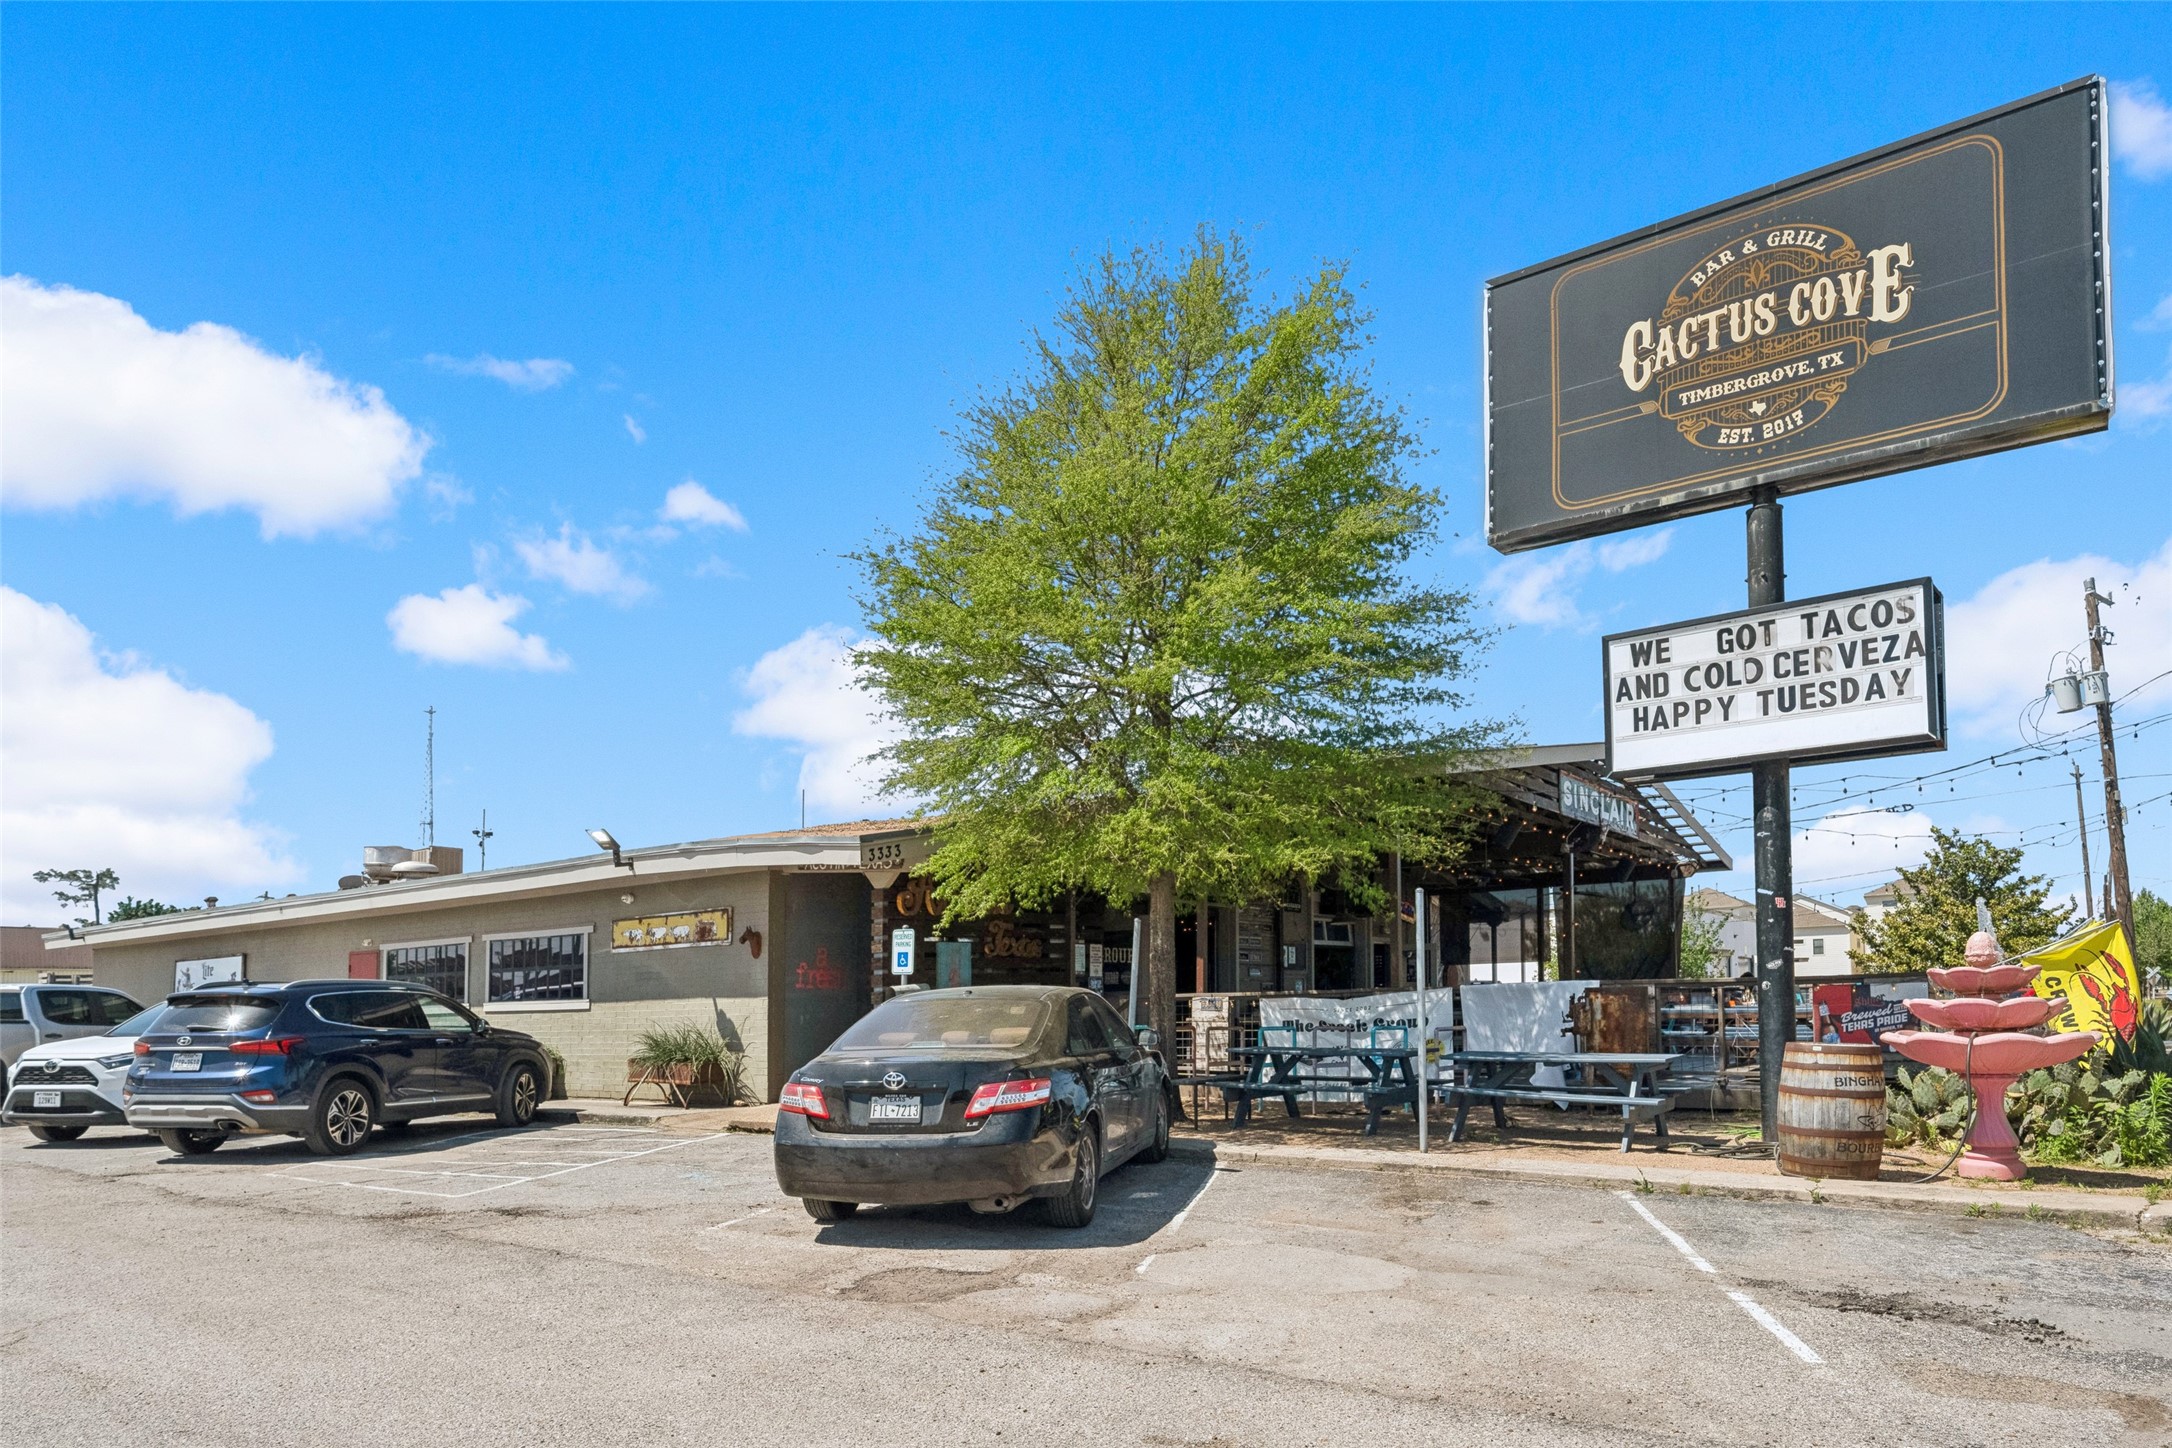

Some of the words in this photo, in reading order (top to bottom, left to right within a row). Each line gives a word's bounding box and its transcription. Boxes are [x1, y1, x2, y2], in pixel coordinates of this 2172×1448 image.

[1690, 250, 1735, 287] BAR
[1742, 239, 1758, 254] &
[1766, 229, 1828, 251] GRILL
[1619, 291, 1777, 392] CACTUS
[1788, 242, 1915, 327] COVE
[1678, 360, 1815, 406] TIMBERGROVE,
[1817, 351, 1844, 370] TX
[1717, 427, 1755, 444] EST.
[1762, 409, 1804, 439] 2017
[1630, 637, 1671, 668] WE
[1717, 619, 1776, 654] GOT
[1800, 595, 1916, 639] TACOS
[1616, 671, 1670, 703] AND
[1683, 657, 1764, 692] COLD
[1773, 630, 1926, 679] CERVEZA
[1633, 695, 1735, 733] HAPPY
[1756, 668, 1912, 716] TUESDAY
[1563, 780, 1637, 833] SINCLAIR
[868, 844, 902, 862] 3333
[1282, 1020, 1314, 1032] The
[1841, 1003, 1893, 1023] Brewed
[1841, 1019, 1875, 1032] TEXAS
[1877, 1013, 1908, 1027] PRIDE
